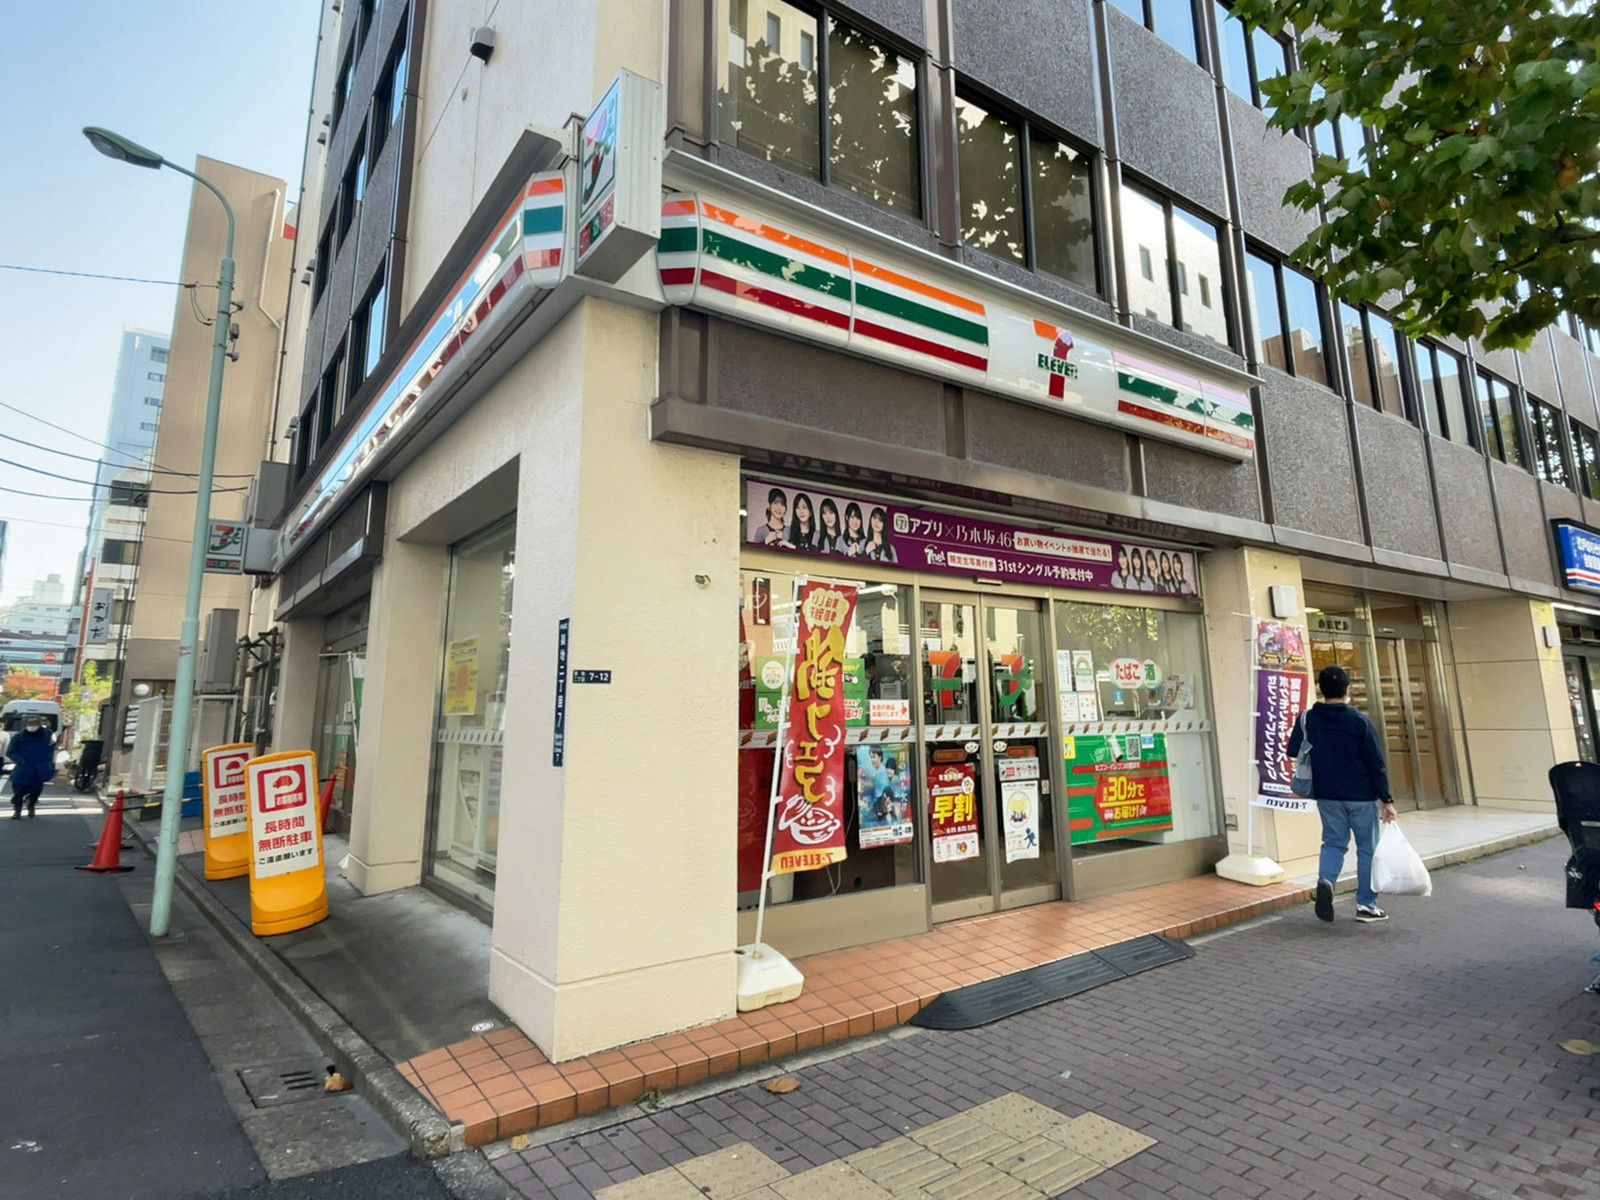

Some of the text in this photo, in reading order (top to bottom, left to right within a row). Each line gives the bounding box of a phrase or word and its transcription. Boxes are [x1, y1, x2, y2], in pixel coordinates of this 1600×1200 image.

[998, 559, 1094, 582] 31stシングル予約受付中
[588, 672, 609, 682] 7-12
[1115, 663, 1141, 680] たばこ
[264, 770, 301, 810] P
[213, 805, 246, 818] 無断駐
[932, 793, 974, 825] 早割
[264, 816, 305, 834] 長時間
[258, 831, 313, 852] 無断駐車
[259, 848, 313, 865] ご遠慮願います
